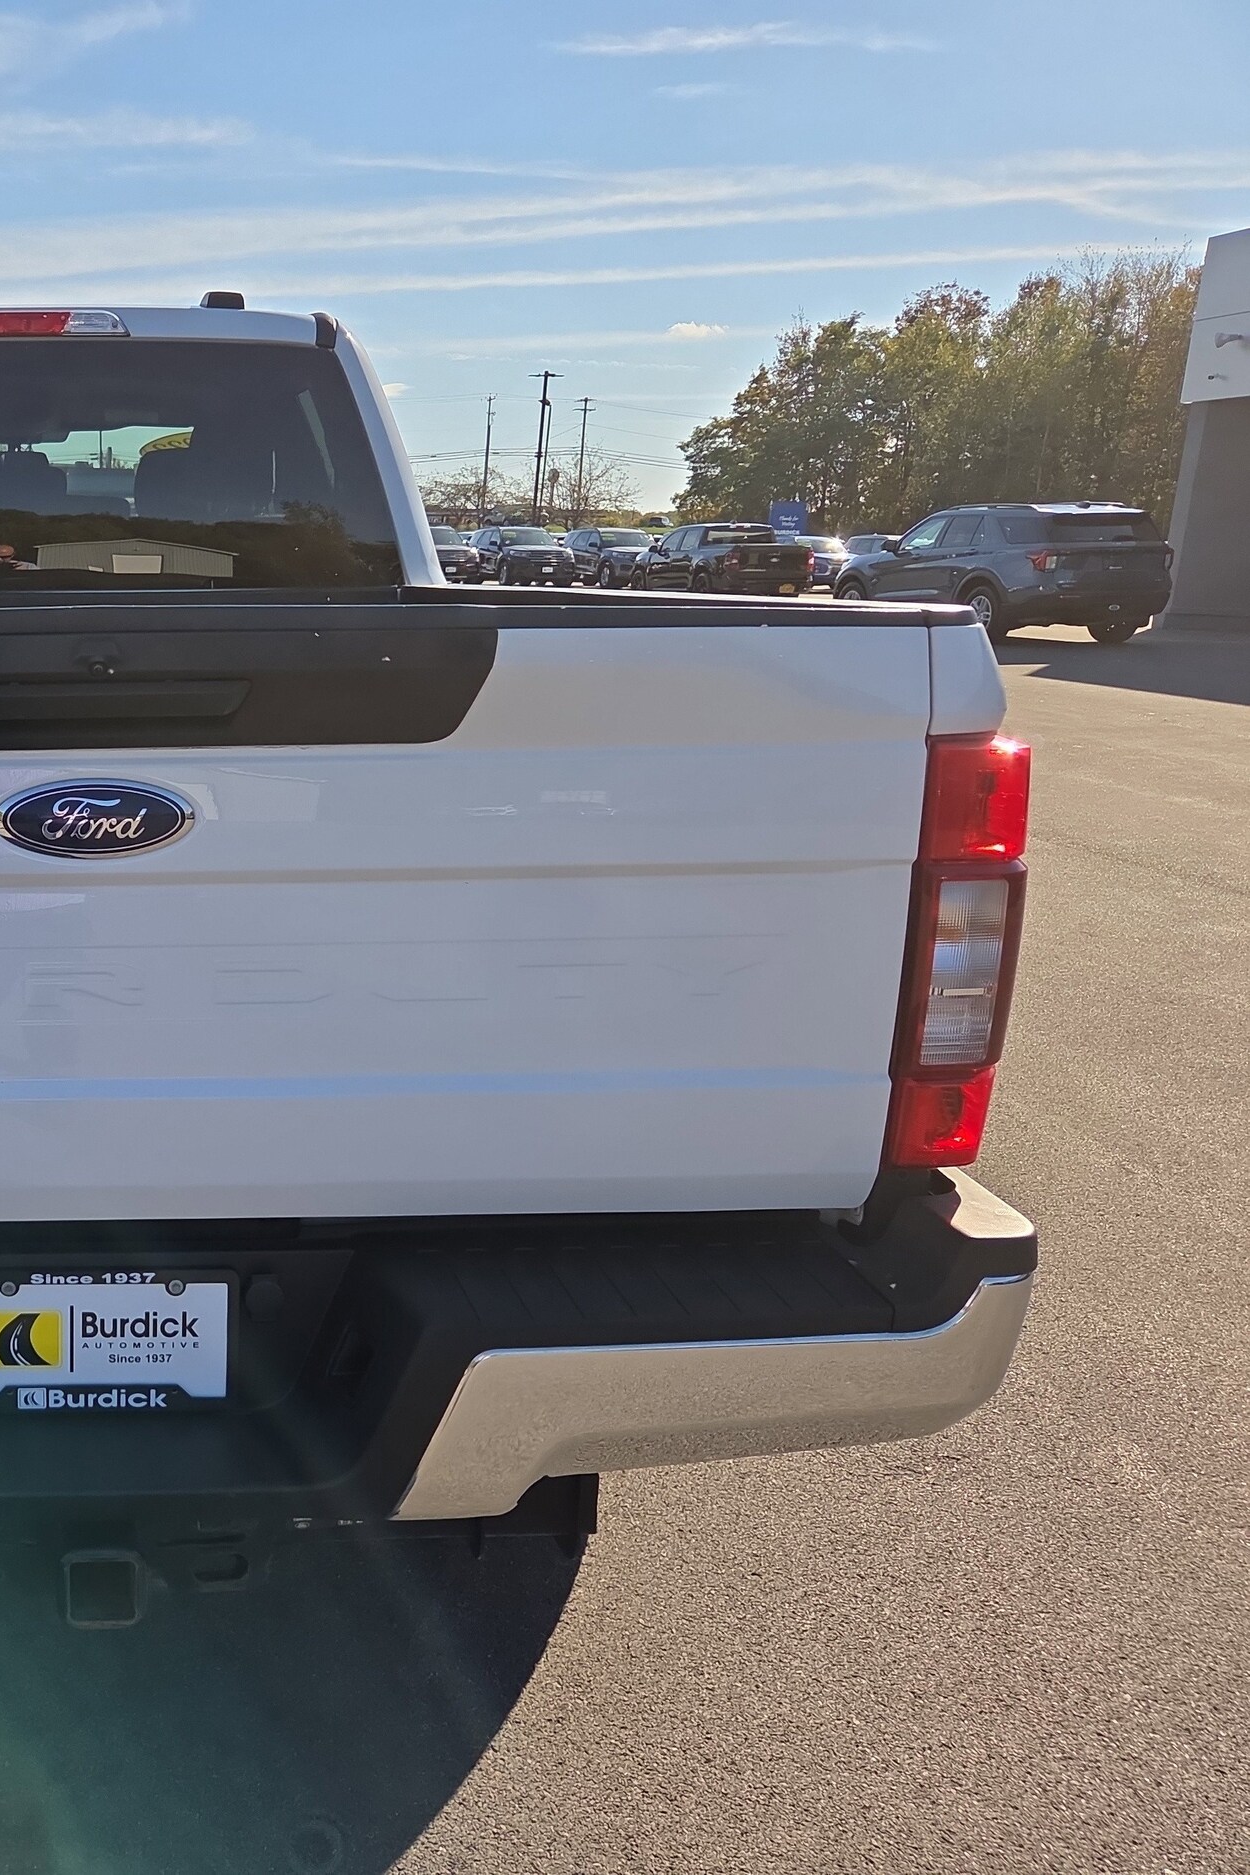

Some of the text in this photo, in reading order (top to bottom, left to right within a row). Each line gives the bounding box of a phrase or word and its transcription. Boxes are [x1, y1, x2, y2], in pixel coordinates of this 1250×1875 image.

[42, 797, 147, 839] Ford
[30, 1272, 156, 1284] Since 1937
[81, 1311, 199, 1338] Burdick
[81, 1341, 200, 1349] AUTOMOTIVE
[108, 1353, 172, 1364] Since 1937
[48, 1389, 167, 1408] Burdick
